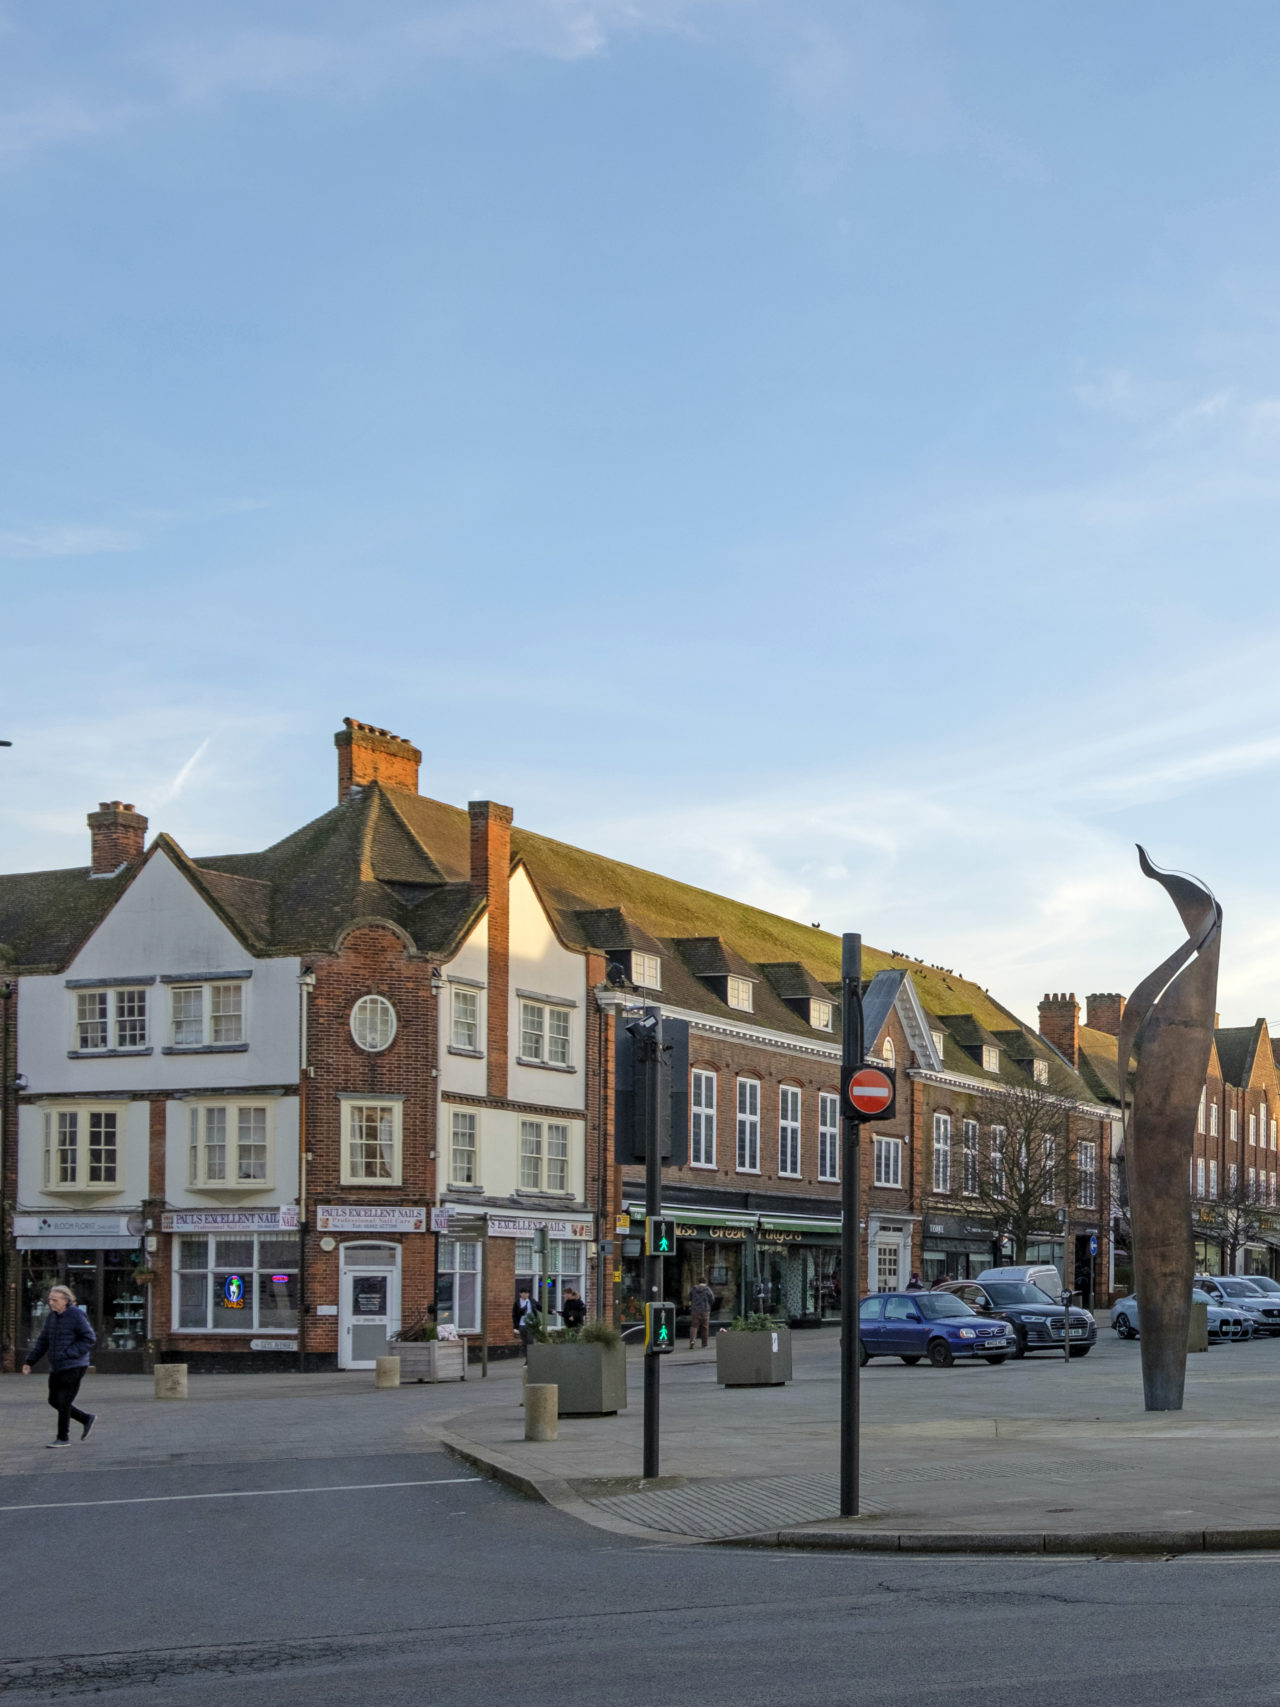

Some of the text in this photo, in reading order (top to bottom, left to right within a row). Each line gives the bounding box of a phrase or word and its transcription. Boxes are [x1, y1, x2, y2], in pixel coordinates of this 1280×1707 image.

[322, 1208, 422, 1218] PAULS EXCELLENT NAILS
[204, 1214, 256, 1224] EXCELLENT
[498, 1220, 544, 1230] EXCELLENT
[709, 1224, 746, 1239] Green
[758, 1230, 802, 1243] Fingers
